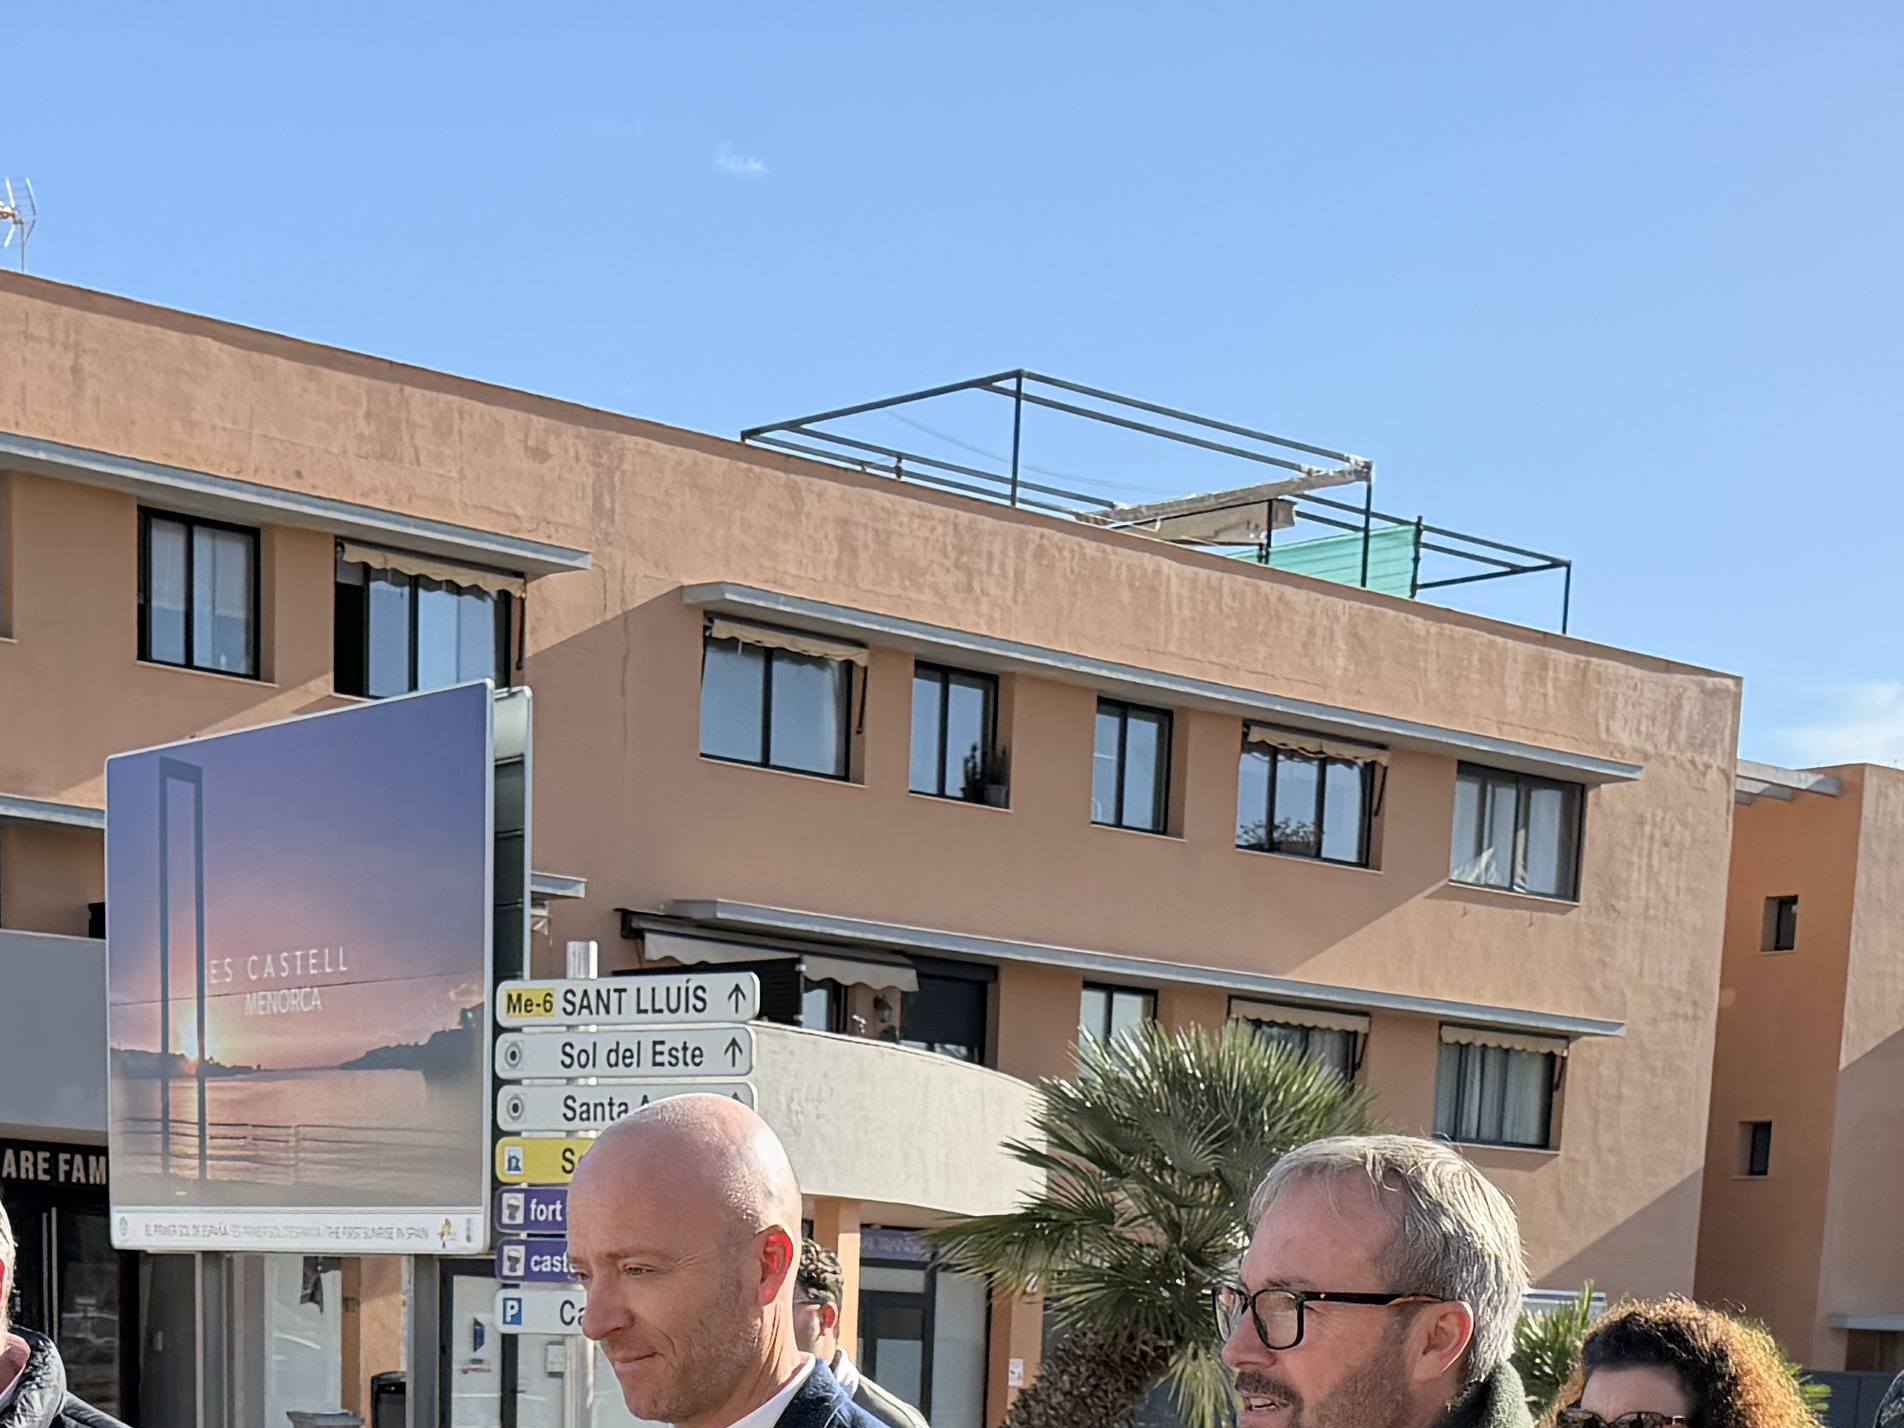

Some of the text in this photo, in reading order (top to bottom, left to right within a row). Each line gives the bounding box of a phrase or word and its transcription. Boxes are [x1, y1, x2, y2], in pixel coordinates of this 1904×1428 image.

[210, 946, 348, 984] ES CASTELL
[245, 986, 323, 1016] MENORCA
[506, 978, 707, 1016] Me-6 SANT LLUÍS
[560, 1040, 704, 1069] Sol del Este
[562, 1094, 629, 1122] Santa
[1, 1148, 52, 1182] ARE
[58, 1152, 107, 1185] FAM
[530, 1198, 563, 1221] fort
